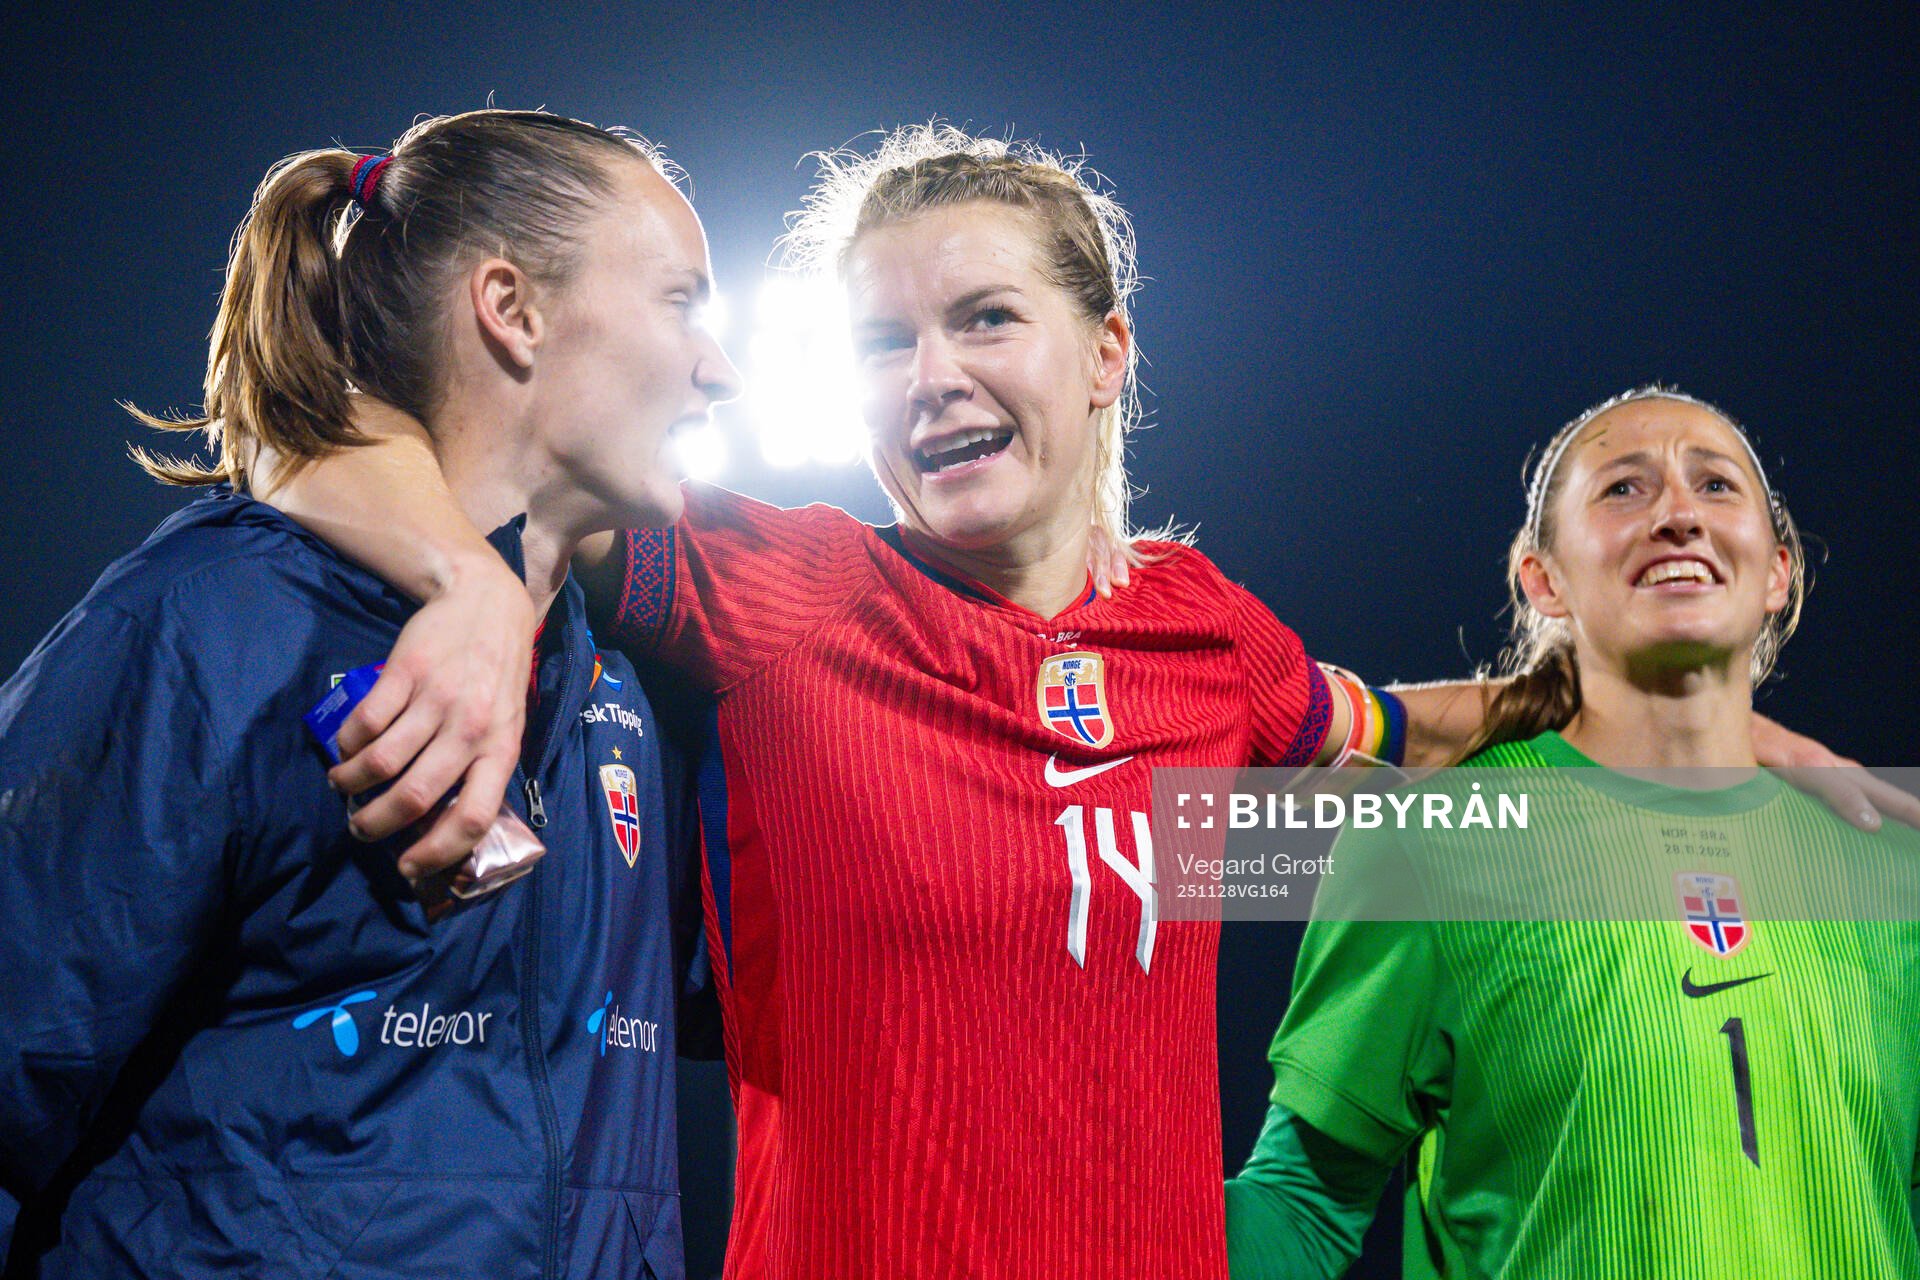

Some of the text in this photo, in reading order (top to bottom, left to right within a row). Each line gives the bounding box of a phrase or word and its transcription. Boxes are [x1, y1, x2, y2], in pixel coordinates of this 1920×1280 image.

[1056, 631, 1081, 643] BRA
[1062, 660, 1081, 670] NORGE
[579, 703, 608, 724] sk
[1054, 805, 1158, 976] 14
[380, 1002, 492, 1049] telenor
[606, 1004, 658, 1053] elenor
[1719, 1017, 1761, 1170] 1
